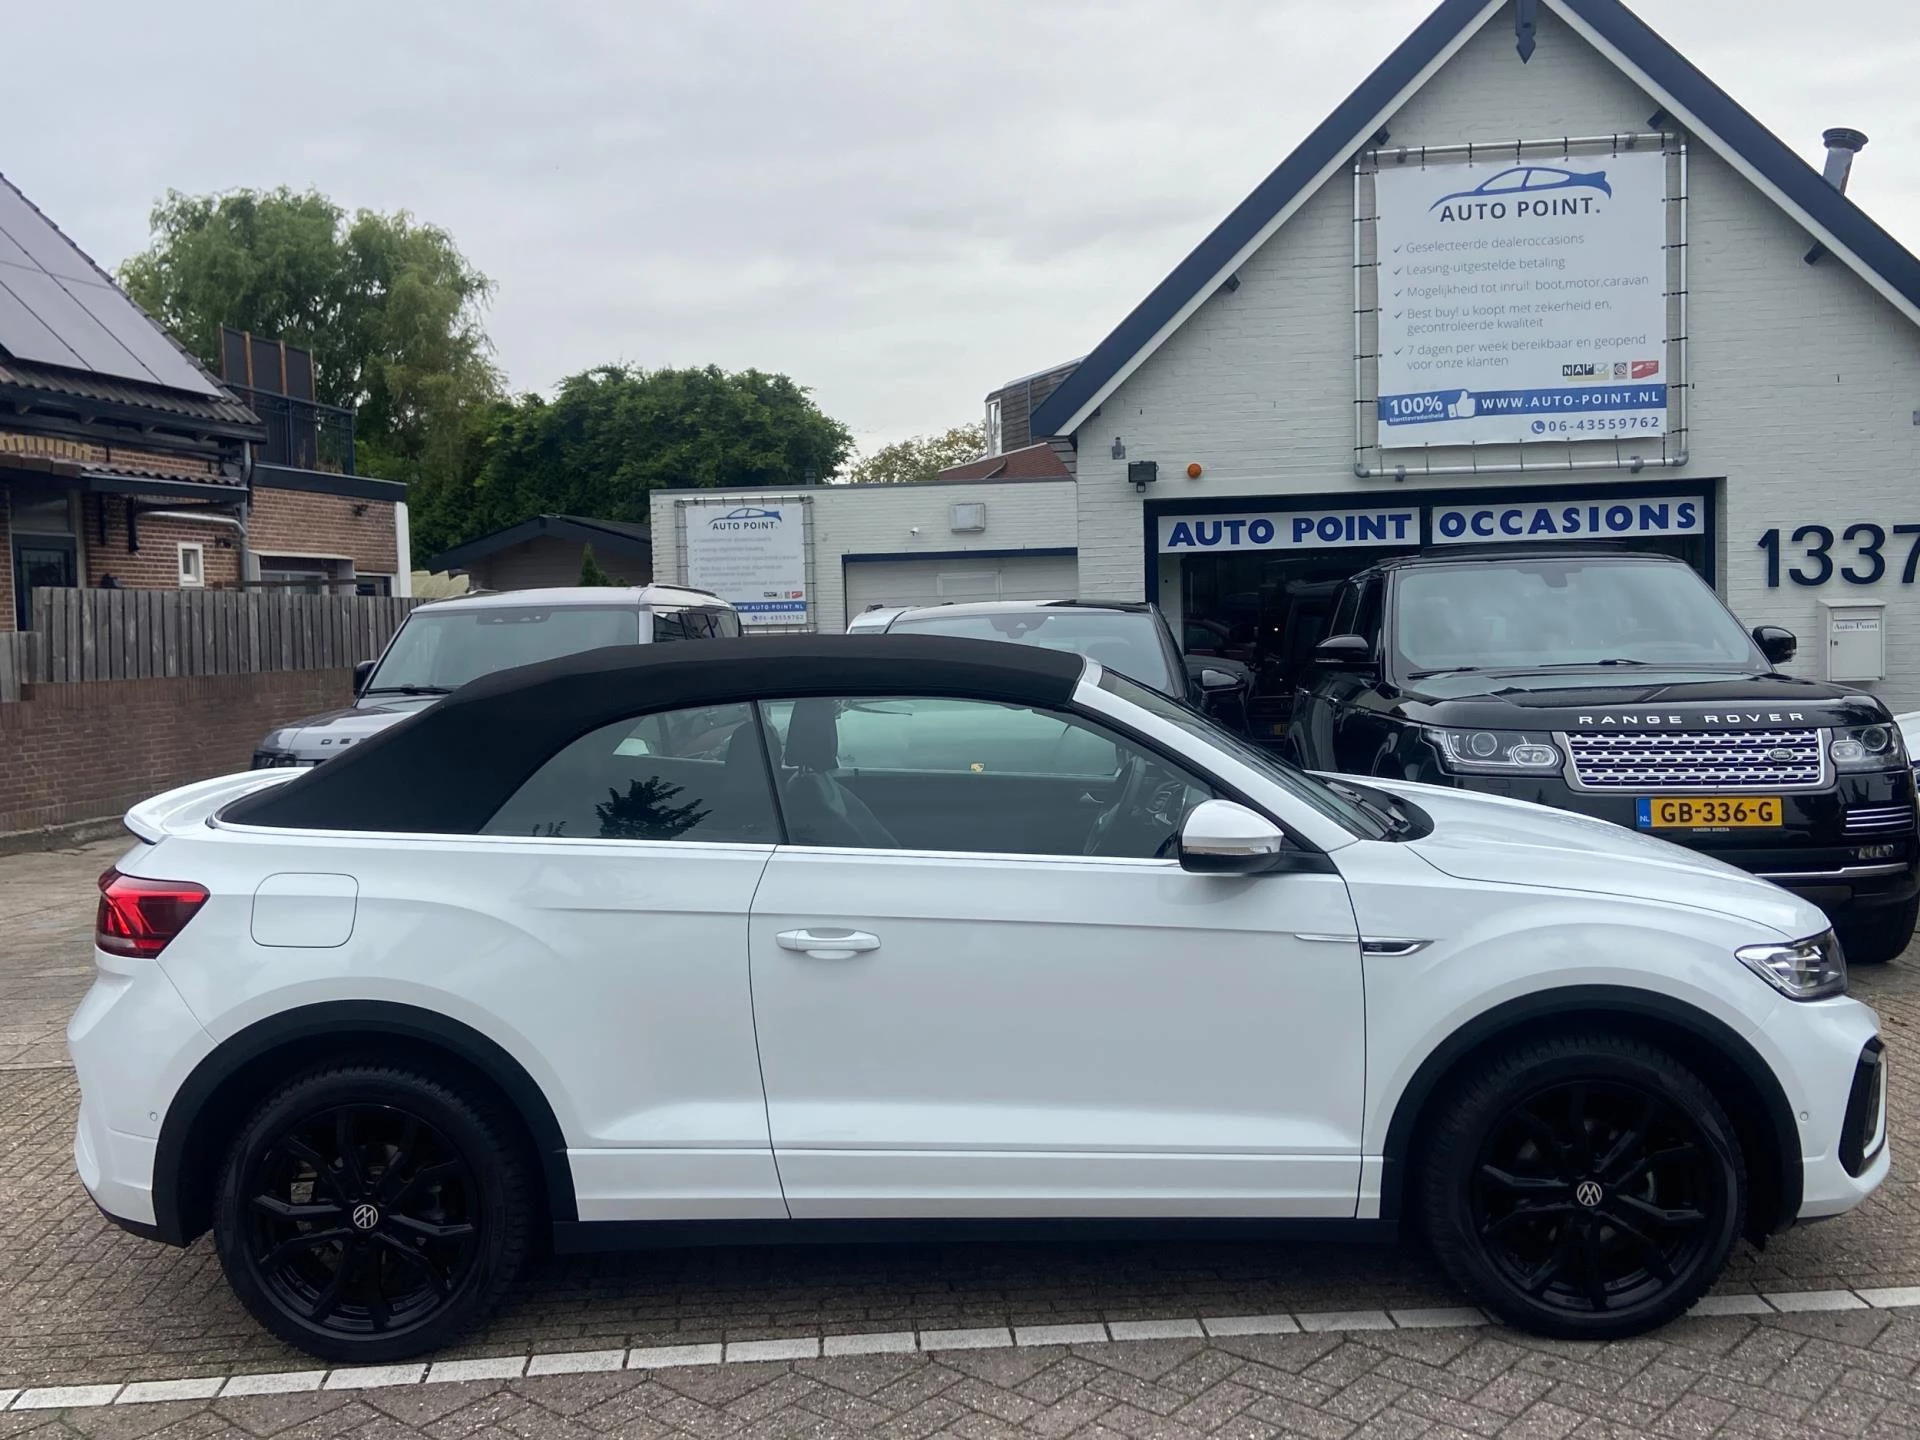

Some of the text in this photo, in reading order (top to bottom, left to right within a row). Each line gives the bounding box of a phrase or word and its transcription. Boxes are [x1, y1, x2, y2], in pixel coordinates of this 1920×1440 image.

[1440, 202, 1507, 222] AUTO
[1406, 234, 1584, 254] Geselecteerde dealeroccasions
[1519, 258, 1565, 270] betaling
[1407, 283, 1478, 299] Mogelijkheid
[1481, 284, 1497, 293] tot
[1407, 308, 1432, 319] Best
[1435, 307, 1459, 319] buy!
[1462, 309, 1470, 317] u
[1472, 304, 1505, 318] koopt
[1509, 304, 1531, 314] met
[1534, 299, 1591, 313] zekerheid
[1407, 318, 1544, 336] gecontroleerde kwaliteit
[1408, 334, 1646, 357] 7 dagen per week bereikbaar en geopend
[1407, 356, 1509, 370] voor onze klanten
[1390, 395, 1443, 415] 100%
[1481, 391, 1660, 409] WWW.AUTO-POINT.NL
[1548, 416, 1660, 432] 06-43559762
[712, 522, 740, 530] AUTO
[1167, 502, 1697, 547] AUTO POINT OCCASIONS
[1757, 523, 1920, 587] 1337
[1579, 713, 1804, 725] RANGE ROVER
[1640, 815, 1650, 823] NL
[1661, 803, 1773, 823] GB-336-G
